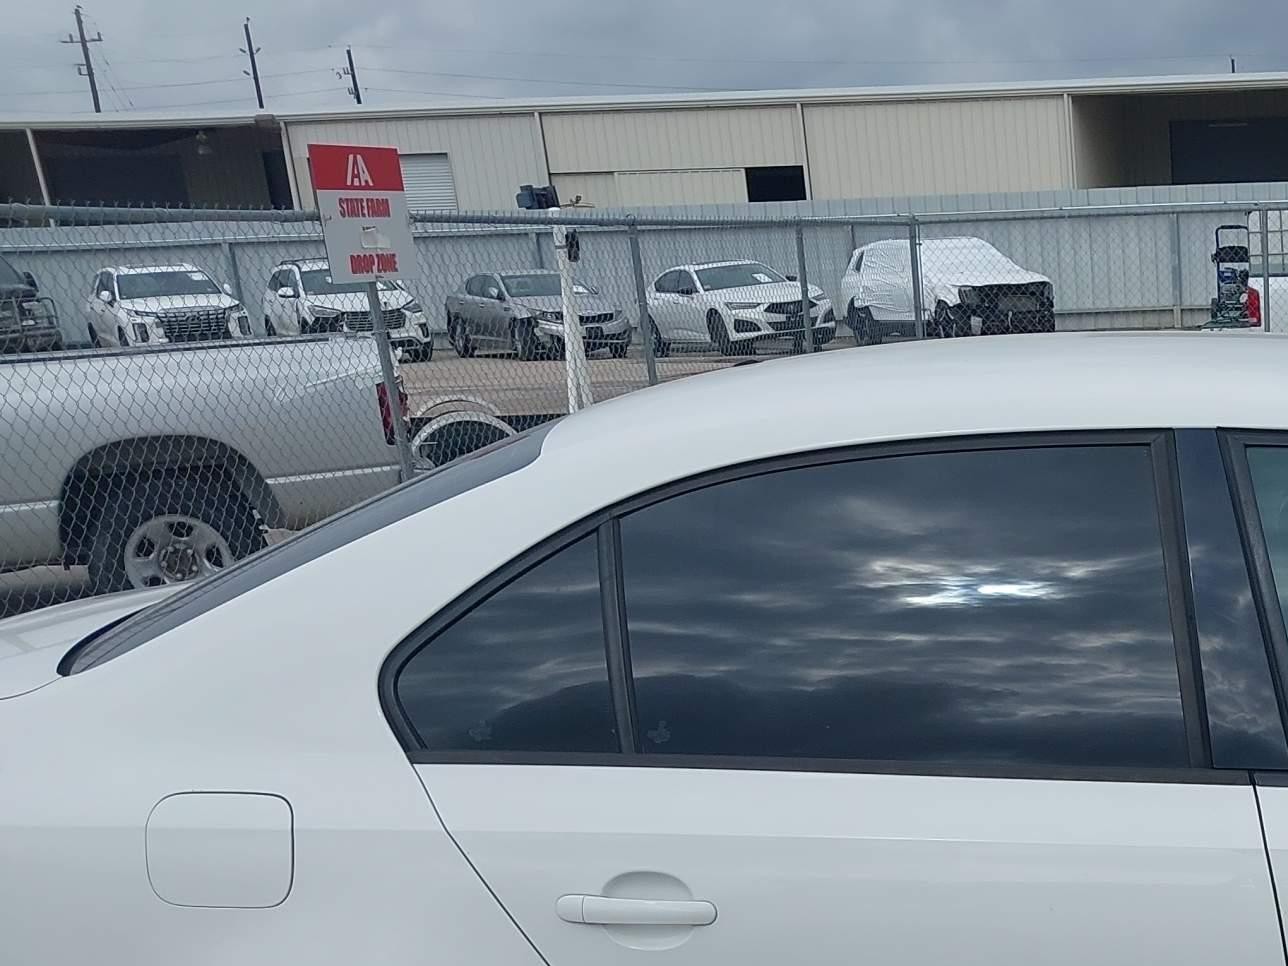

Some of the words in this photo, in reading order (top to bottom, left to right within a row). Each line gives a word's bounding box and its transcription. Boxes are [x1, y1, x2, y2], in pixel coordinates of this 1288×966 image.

[338, 197, 366, 218] STATE
[366, 198, 391, 218] FARM
[349, 253, 376, 274] DROP
[375, 252, 399, 273] ZONE
